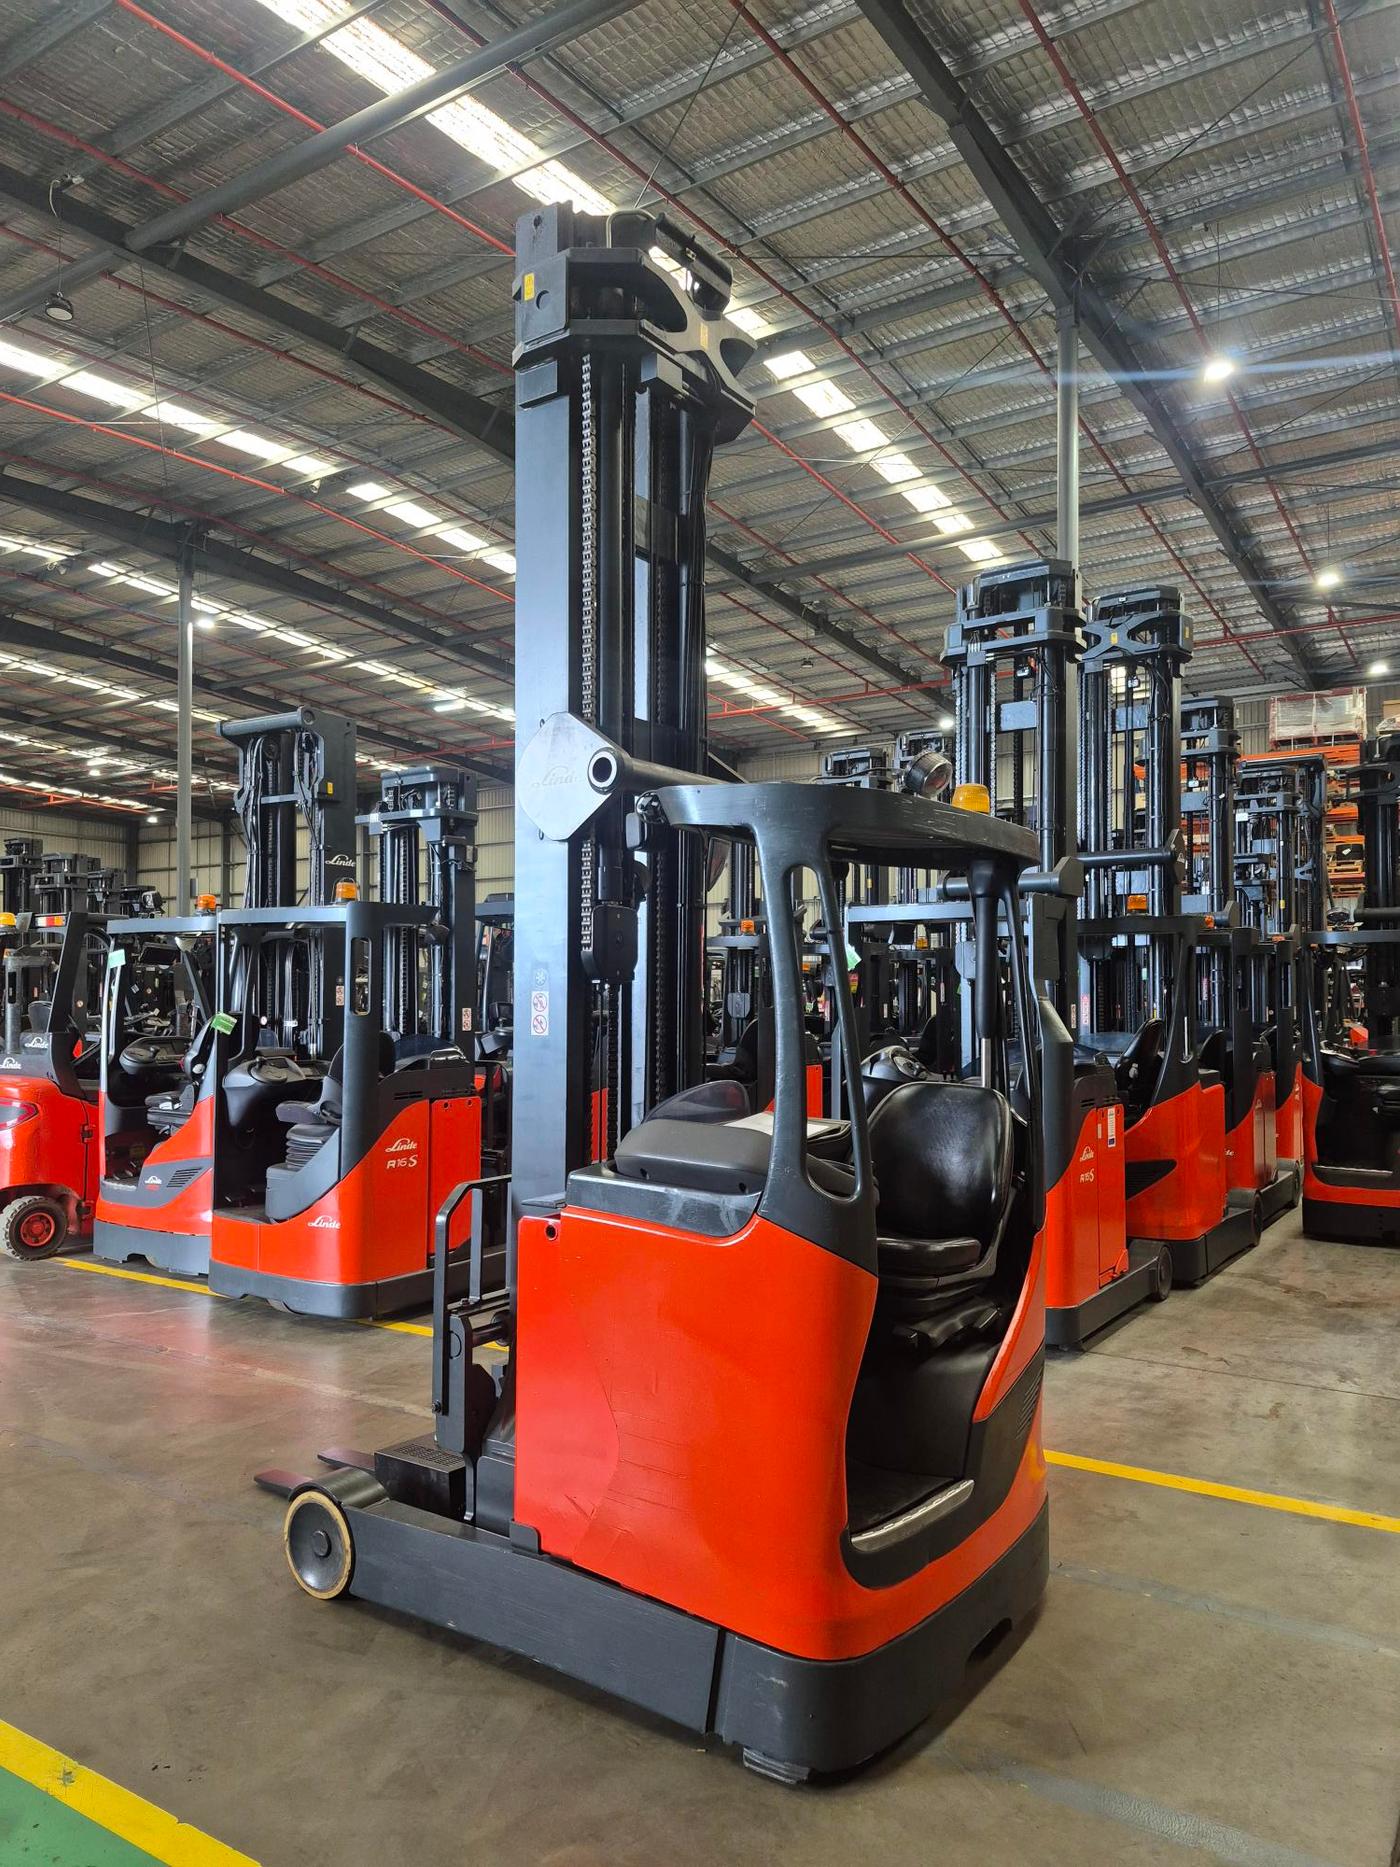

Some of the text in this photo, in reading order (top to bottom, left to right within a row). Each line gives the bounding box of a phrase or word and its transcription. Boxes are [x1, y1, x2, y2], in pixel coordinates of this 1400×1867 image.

[325, 854, 356, 867] Linde
[24, 1036, 49, 1049] Linde
[385, 1137, 418, 1153] Linde
[307, 1214, 341, 1229] Linde
